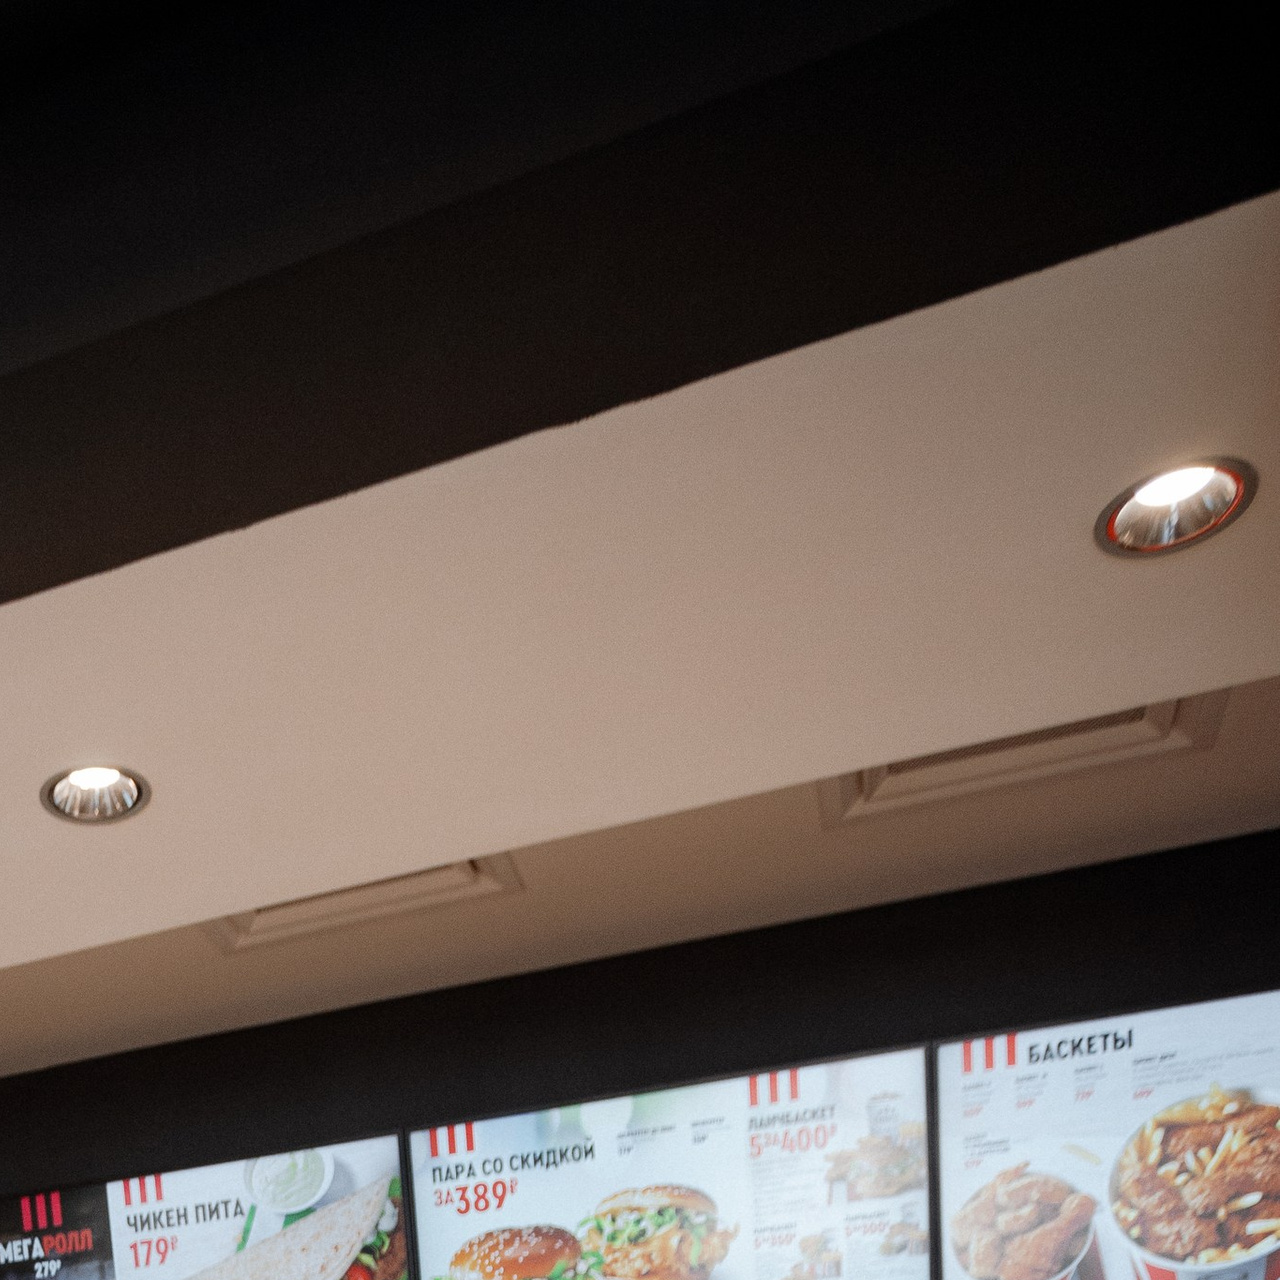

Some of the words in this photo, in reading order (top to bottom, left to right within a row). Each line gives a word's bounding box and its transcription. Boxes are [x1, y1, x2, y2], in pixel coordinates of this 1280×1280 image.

[1028, 1029, 1134, 1066] БАСКЕТЫ
[432, 1163, 477, 1184] ПАРА
[482, 1157, 503, 1176] СО
[509, 1136, 595, 1171] СКИДКОЙ
[126, 1206, 188, 1233] ЧИКЕН
[195, 1197, 245, 1223] ПИТА
